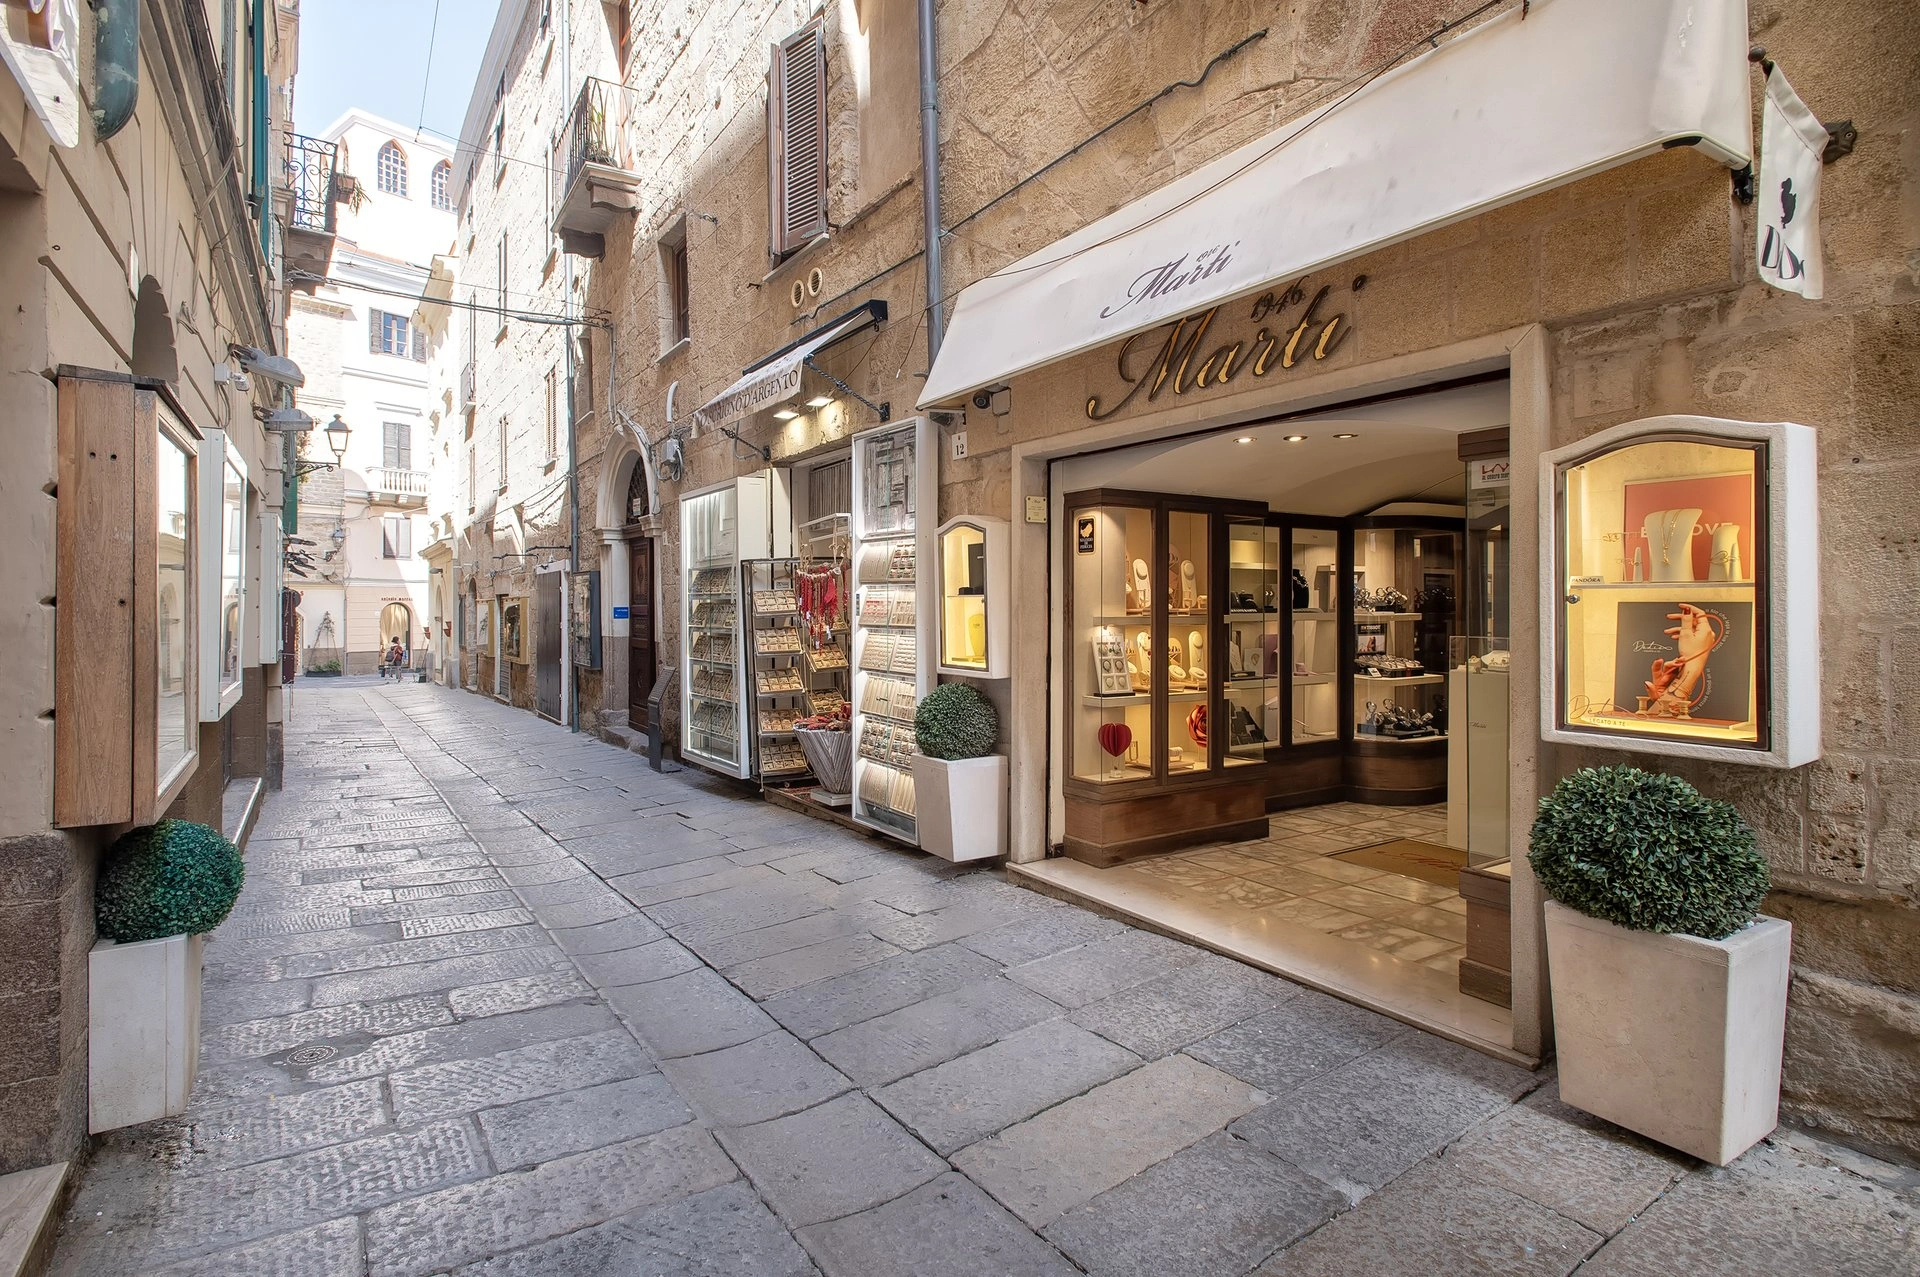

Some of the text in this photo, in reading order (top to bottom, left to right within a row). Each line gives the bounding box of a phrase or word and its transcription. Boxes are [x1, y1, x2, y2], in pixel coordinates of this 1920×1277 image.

[1100, 240, 1240, 319] Marti
[1250, 275, 1310, 323] 1946
[1086, 275, 1369, 419] Marti
[743, 370, 798, 409] D'ARGENTO
[956, 443, 965, 455] 12
